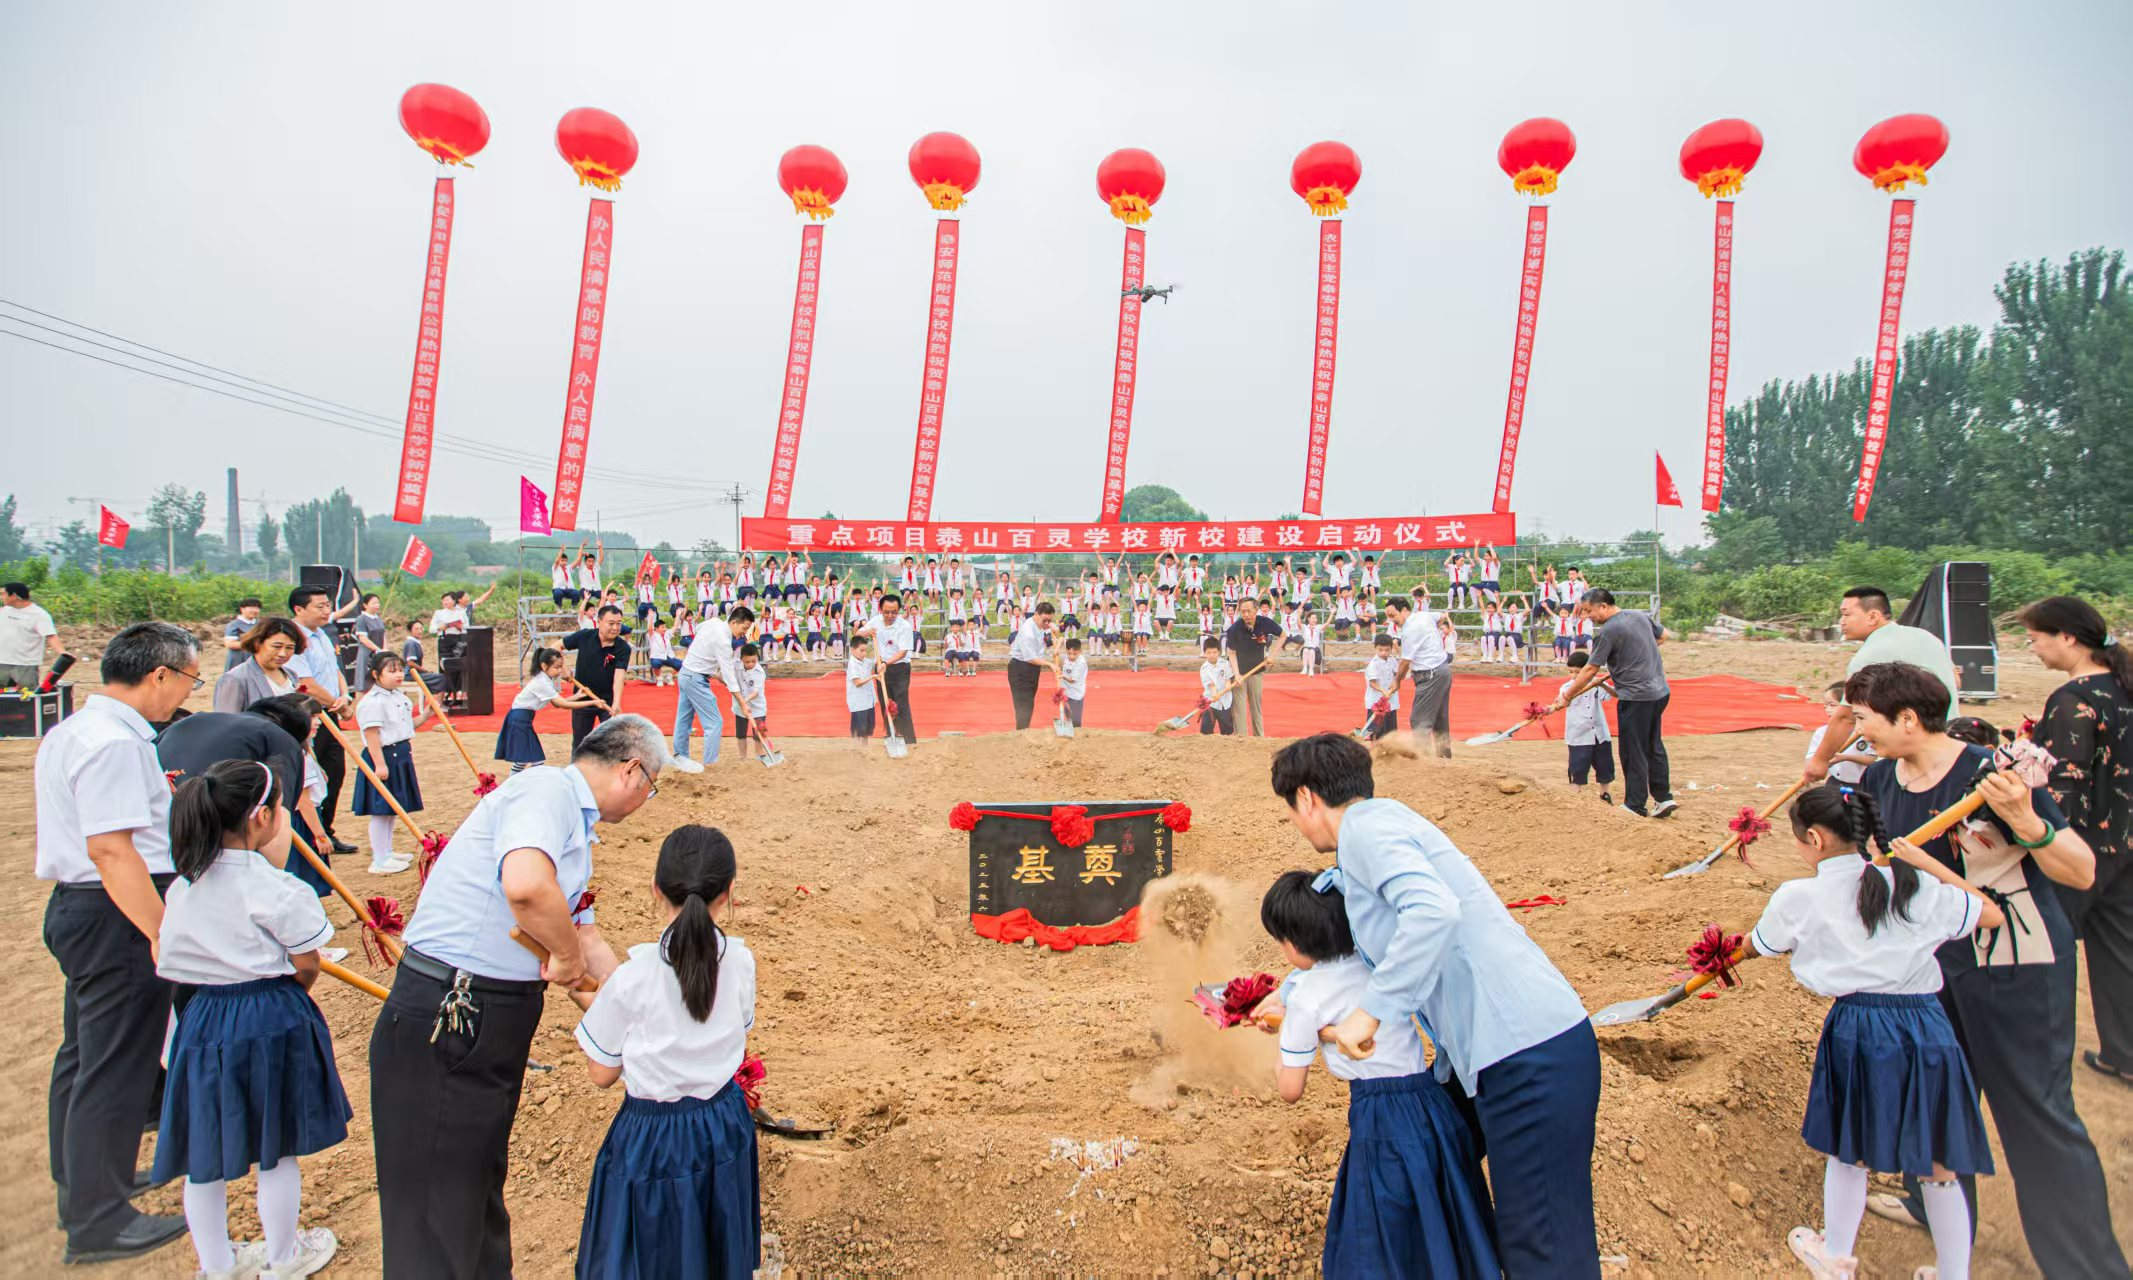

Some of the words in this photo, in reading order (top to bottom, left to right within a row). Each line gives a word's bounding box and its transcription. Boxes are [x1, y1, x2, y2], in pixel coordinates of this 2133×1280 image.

[576, 215, 609, 359] 办人民满意的教育
[558, 370, 592, 513] 办人民满意的学校
[787, 521, 1466, 548] 重点项目泰山百灵学校新校建设启动仪式
